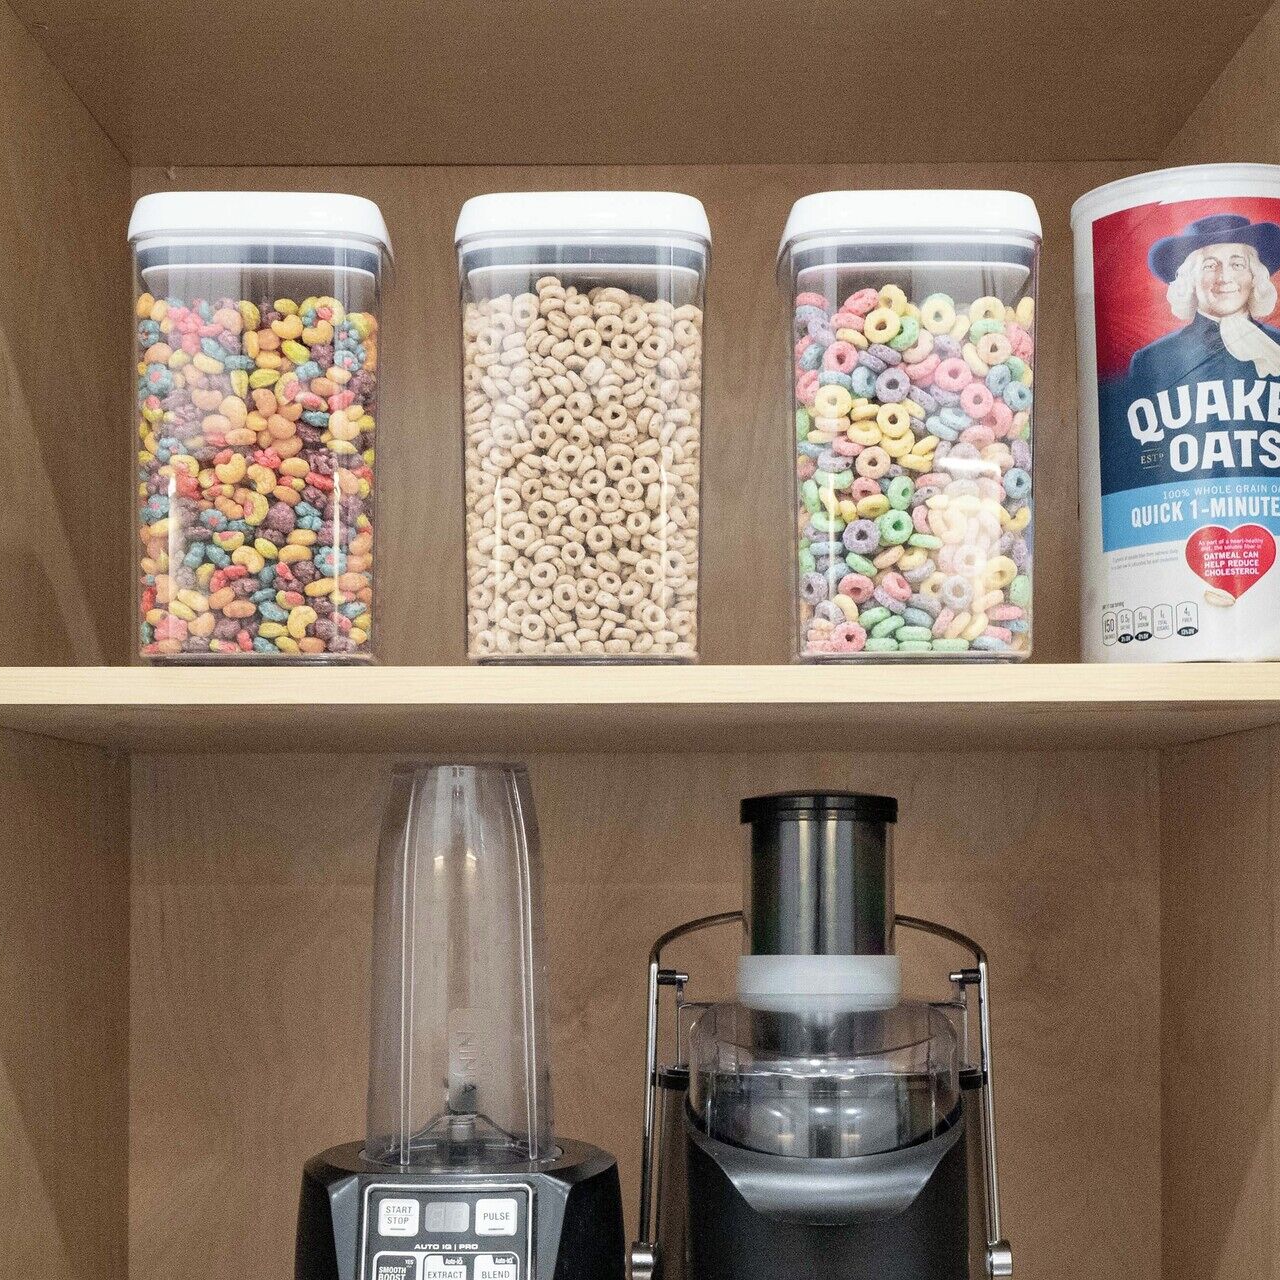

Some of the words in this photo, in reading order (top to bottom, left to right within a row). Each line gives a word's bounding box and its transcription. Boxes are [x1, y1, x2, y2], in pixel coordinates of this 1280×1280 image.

[1162, 489, 1190, 500] 100%
[1194, 485, 1232, 496] WHOLE
[1236, 485, 1268, 494] GRAIN
[1131, 500, 1184, 527] QUICK
[1190, 496, 1280, 519] 1-MINUTE
[1204, 552, 1241, 561] OATMEAL
[1243, 551, 1259, 559] CAN
[1204, 560, 1225, 569] HELP
[1228, 559, 1259, 568] REDUCE
[1205, 568, 1259, 577] CHOLESTEROL
[1104, 619, 1115, 633] 150
[385, 1206, 412, 1214] START
[483, 1212, 510, 1220] PULSE
[387, 1217, 409, 1225] STOP
[379, 1266, 407, 1274] SMOOTH
[427, 1271, 463, 1279] EXTRACT
[481, 1271, 510, 1279] BLEND
